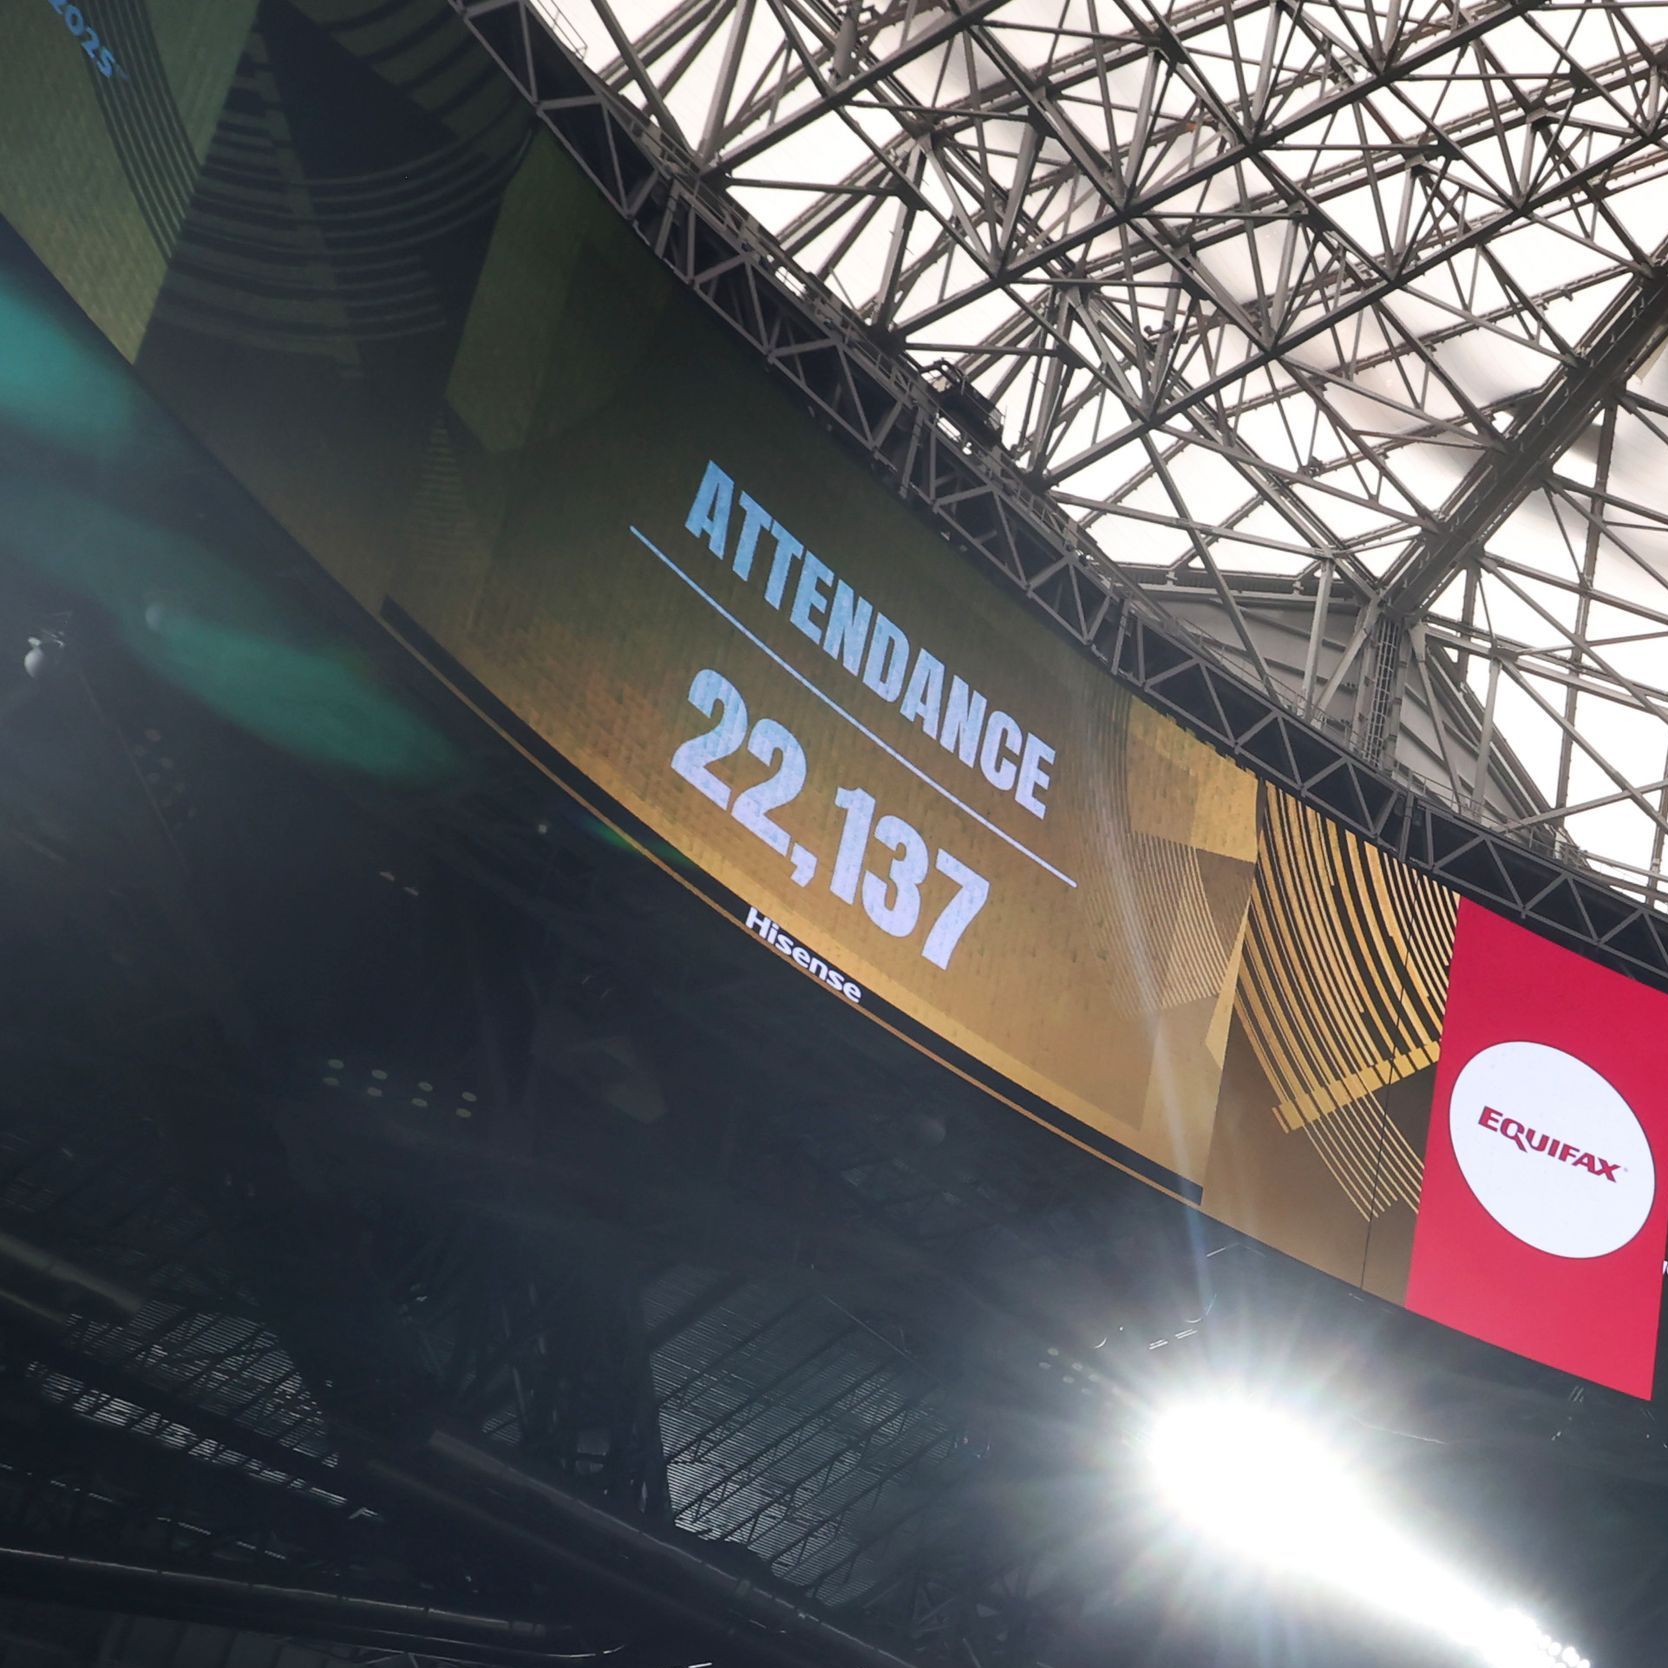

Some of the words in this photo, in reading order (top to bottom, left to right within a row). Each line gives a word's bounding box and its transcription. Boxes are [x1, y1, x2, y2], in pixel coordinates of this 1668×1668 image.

[685, 459, 1056, 821] ATTENDANCE
[670, 668, 990, 970] 22,137
[744, 907, 863, 1004] Hisense
[1477, 1104, 1622, 1184] EQUIFAX
